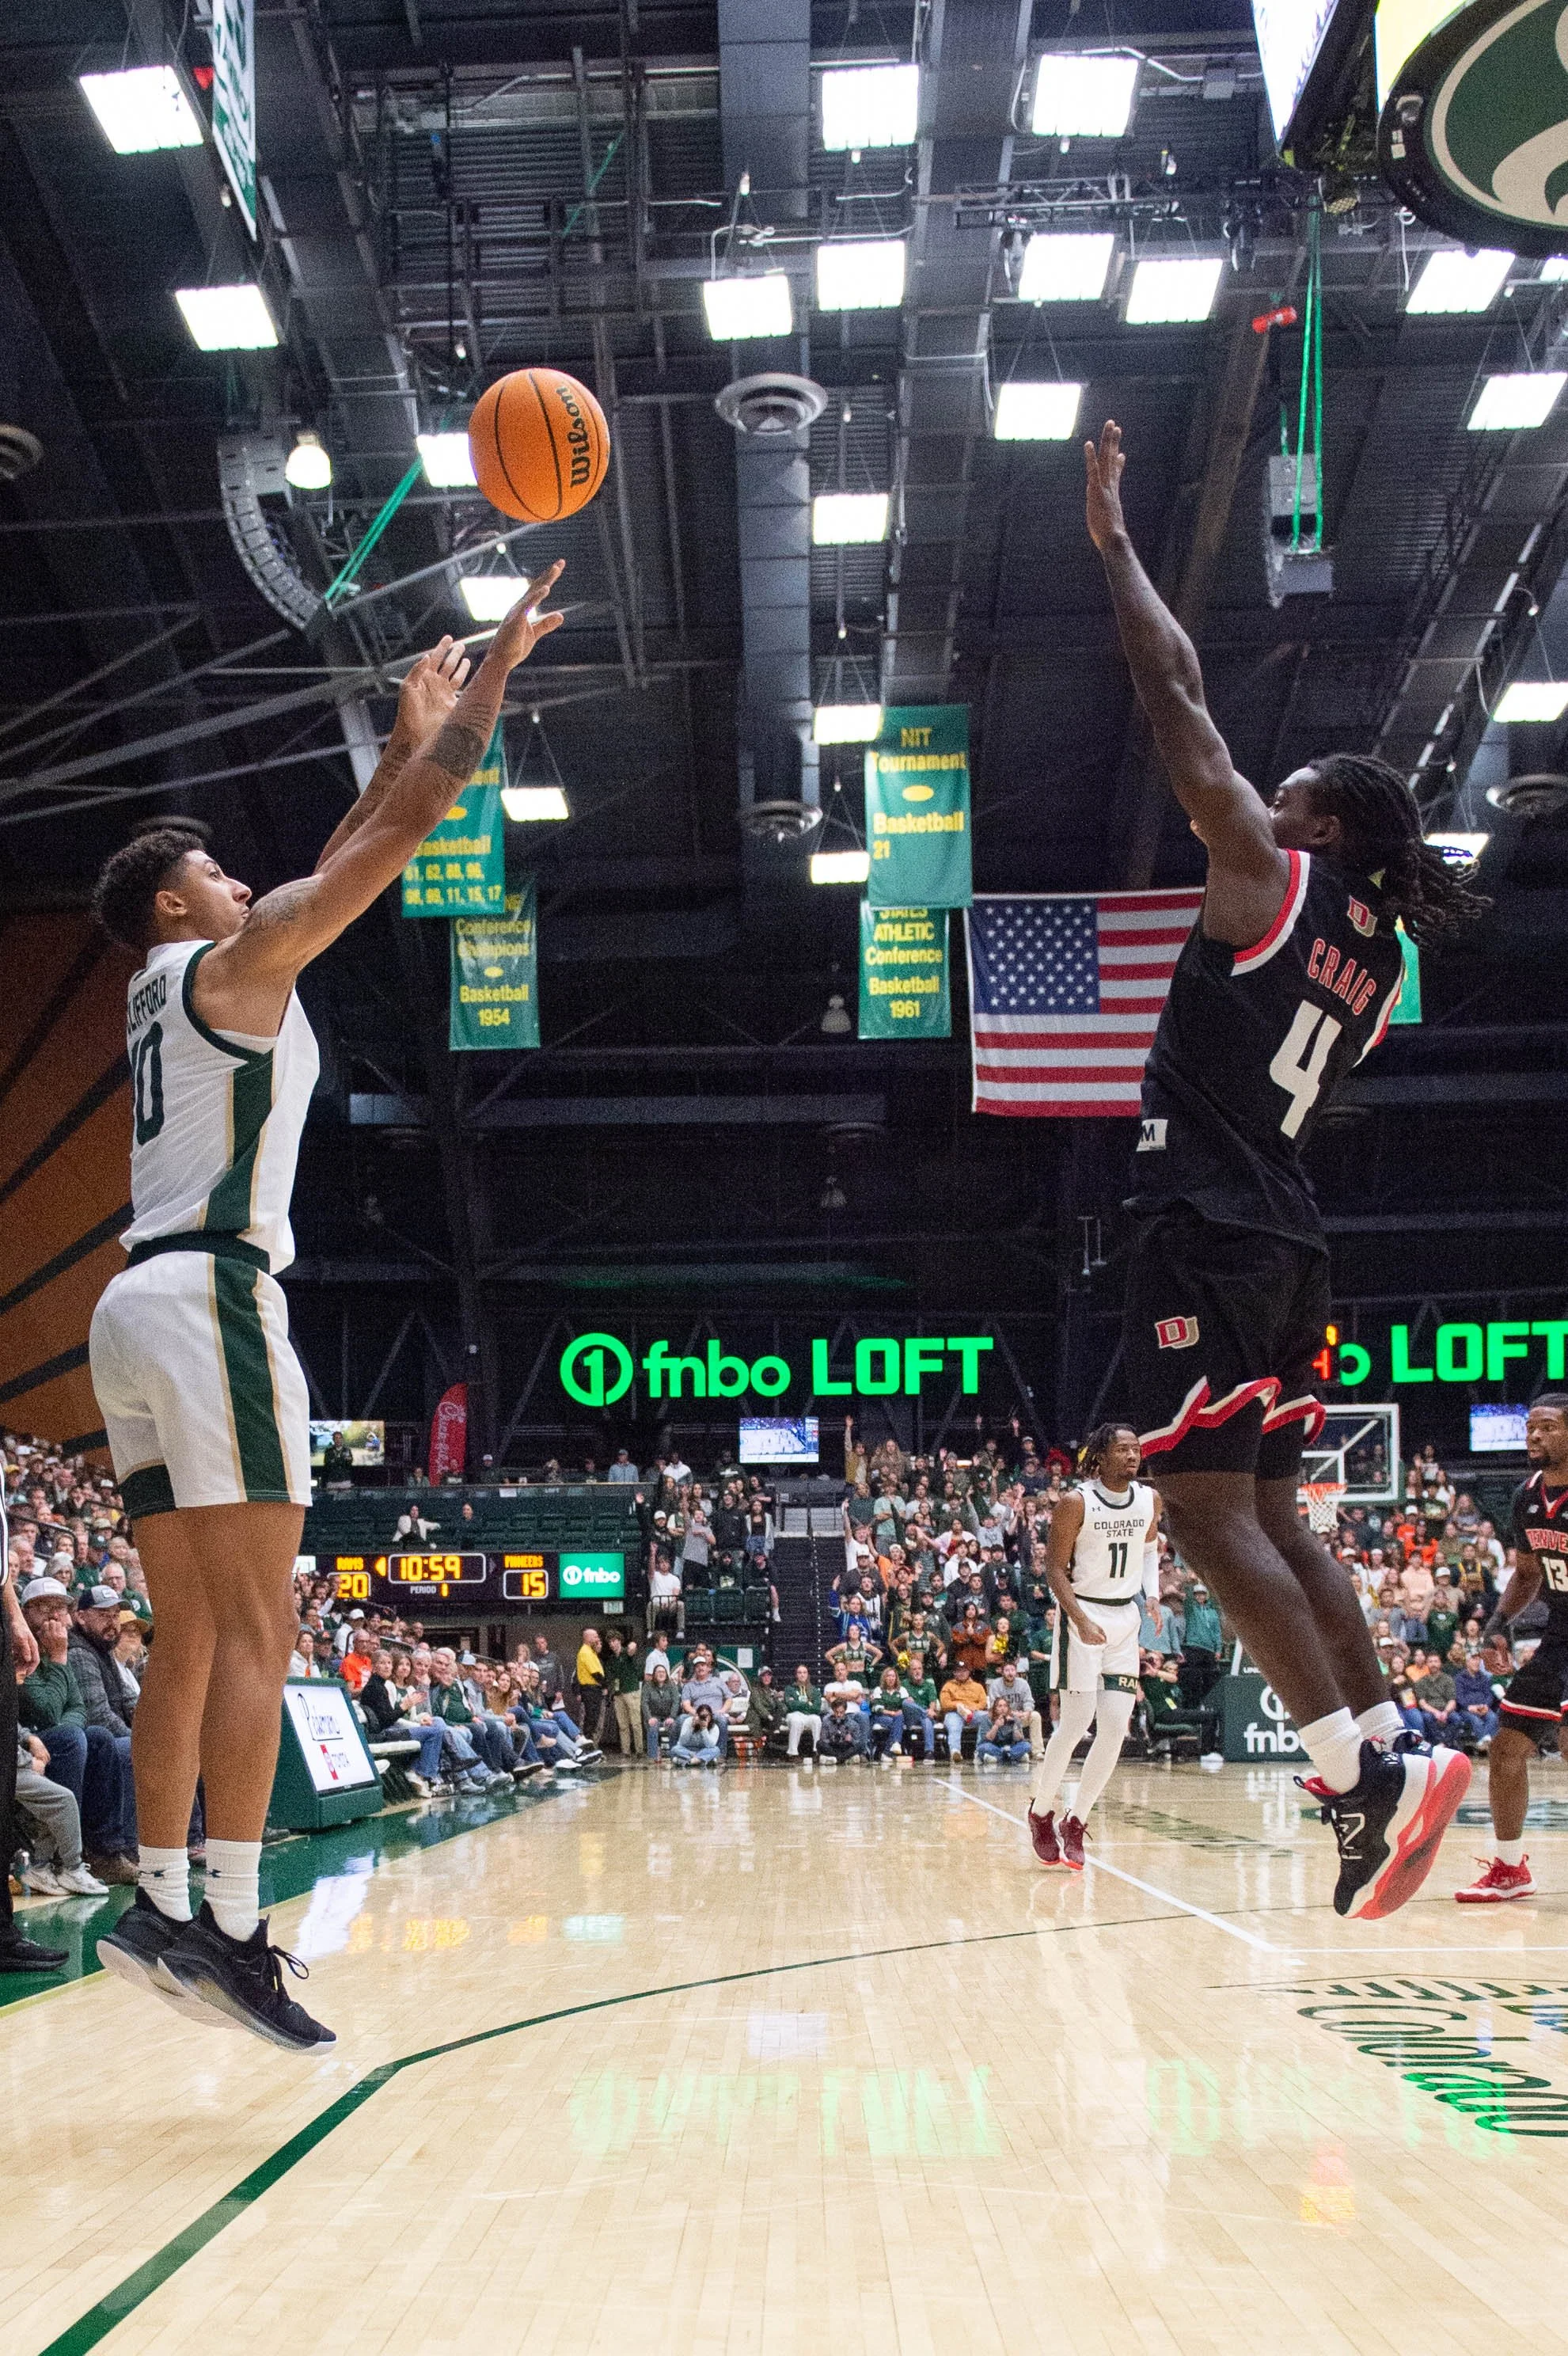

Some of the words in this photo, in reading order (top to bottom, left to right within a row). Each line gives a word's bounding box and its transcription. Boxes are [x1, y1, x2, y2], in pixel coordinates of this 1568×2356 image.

[556, 386, 591, 488] Wilson
[900, 728, 932, 747] NIT
[873, 751, 966, 773] Tournament
[873, 811, 964, 834] Basketball
[873, 840, 890, 860] 21
[488, 884, 502, 901] 17
[874, 922, 935, 941] ATHLETIC
[865, 946, 943, 965] Conference
[869, 976, 940, 995] Basketball
[1308, 938, 1376, 1016] CRAIG
[460, 984, 529, 1003] Basketball
[127, 975, 166, 1036] LIFFORD
[890, 1001, 921, 1019] 1961
[478, 1009, 511, 1027] 1954
[1270, 1000, 1342, 1139] 4
[1391, 1320, 1568, 1383] LOFT
[643, 1340, 791, 1397] fnbo
[812, 1337, 993, 1395] LOFT
[1094, 1519, 1145, 1530] COLORADO
[1106, 1529, 1134, 1537] STATE
[400, 1556, 461, 1582] 10:59
[1108, 1542, 1128, 1578] 11
[522, 1571, 546, 1597] 15
[583, 1567, 621, 1583] fnbo
[1542, 1556, 1568, 1592] 13
[337, 1574, 369, 1598] 20
[410, 1586, 436, 1594] PERIOD
[441, 1583, 449, 1597] 1
[1118, 1676, 1137, 1689] RA
